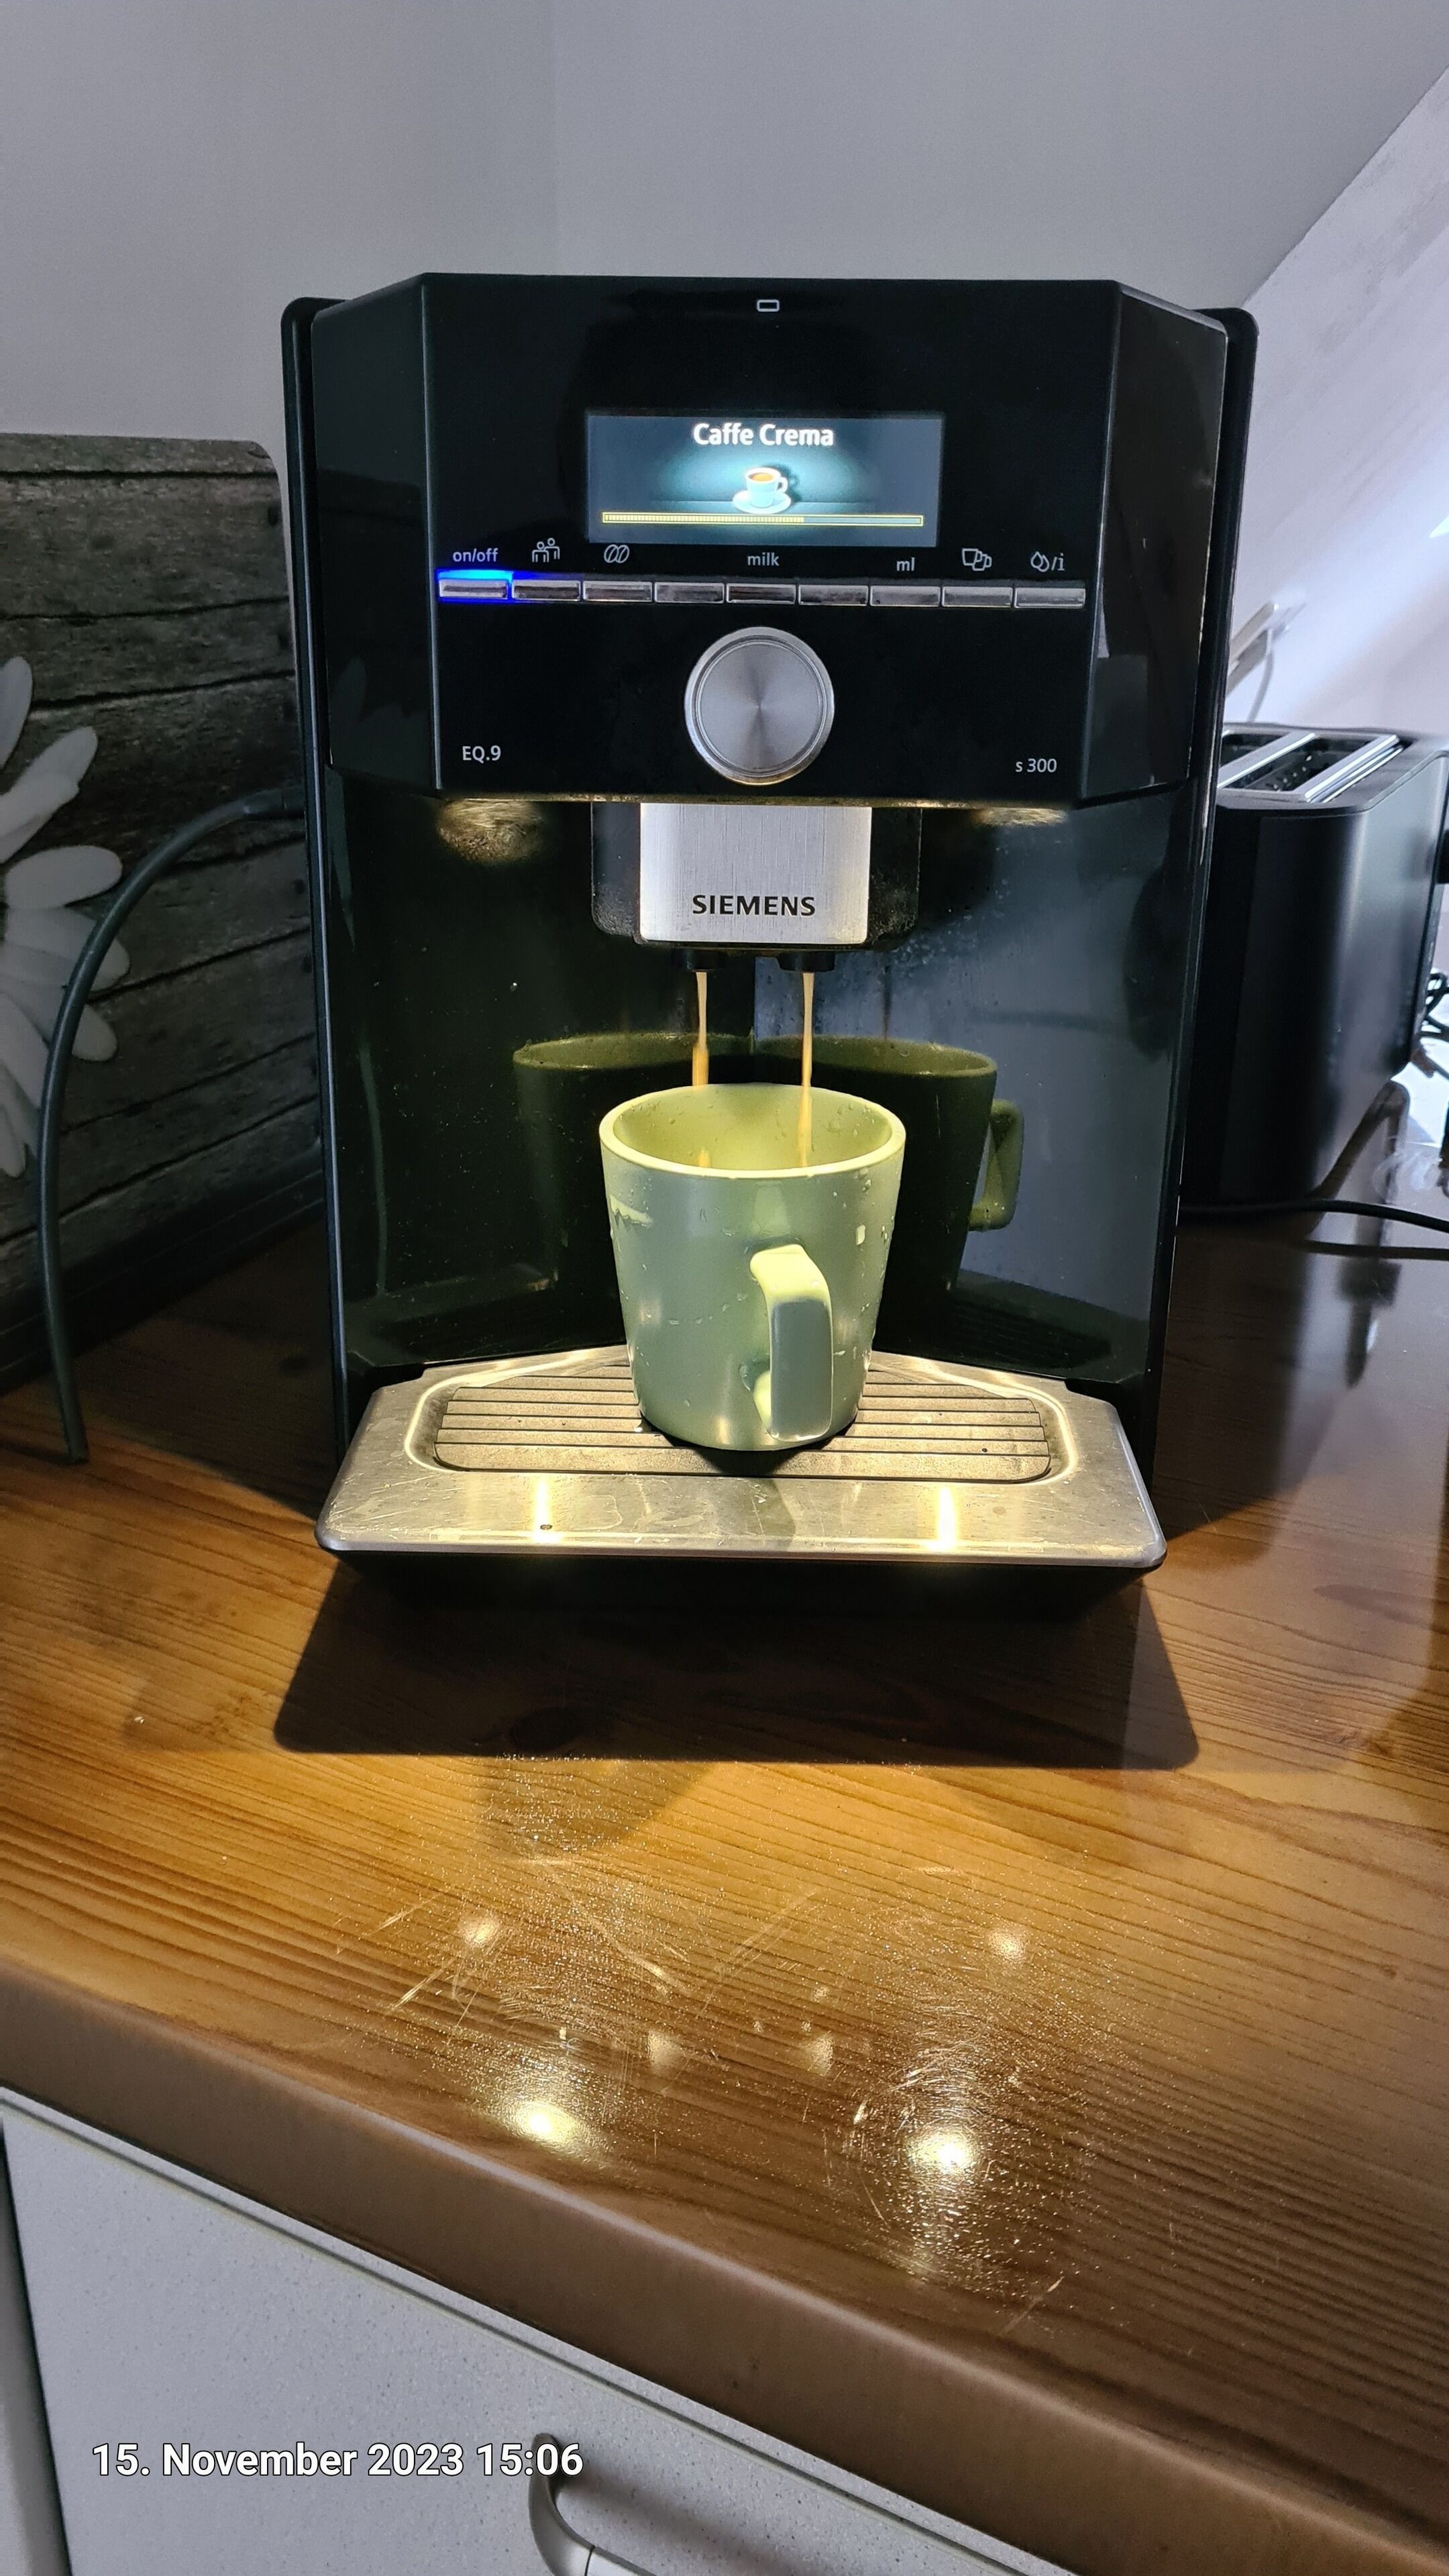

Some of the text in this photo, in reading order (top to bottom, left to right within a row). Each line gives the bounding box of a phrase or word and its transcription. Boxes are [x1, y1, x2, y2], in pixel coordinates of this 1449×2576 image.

[692, 422, 835, 447] Caffe Crema
[452, 547, 499, 563] on/off
[747, 551, 780, 567] milk
[896, 556, 916, 572] ml
[462, 745, 502, 764] EQ.9
[692, 894, 816, 916] SIEMENS
